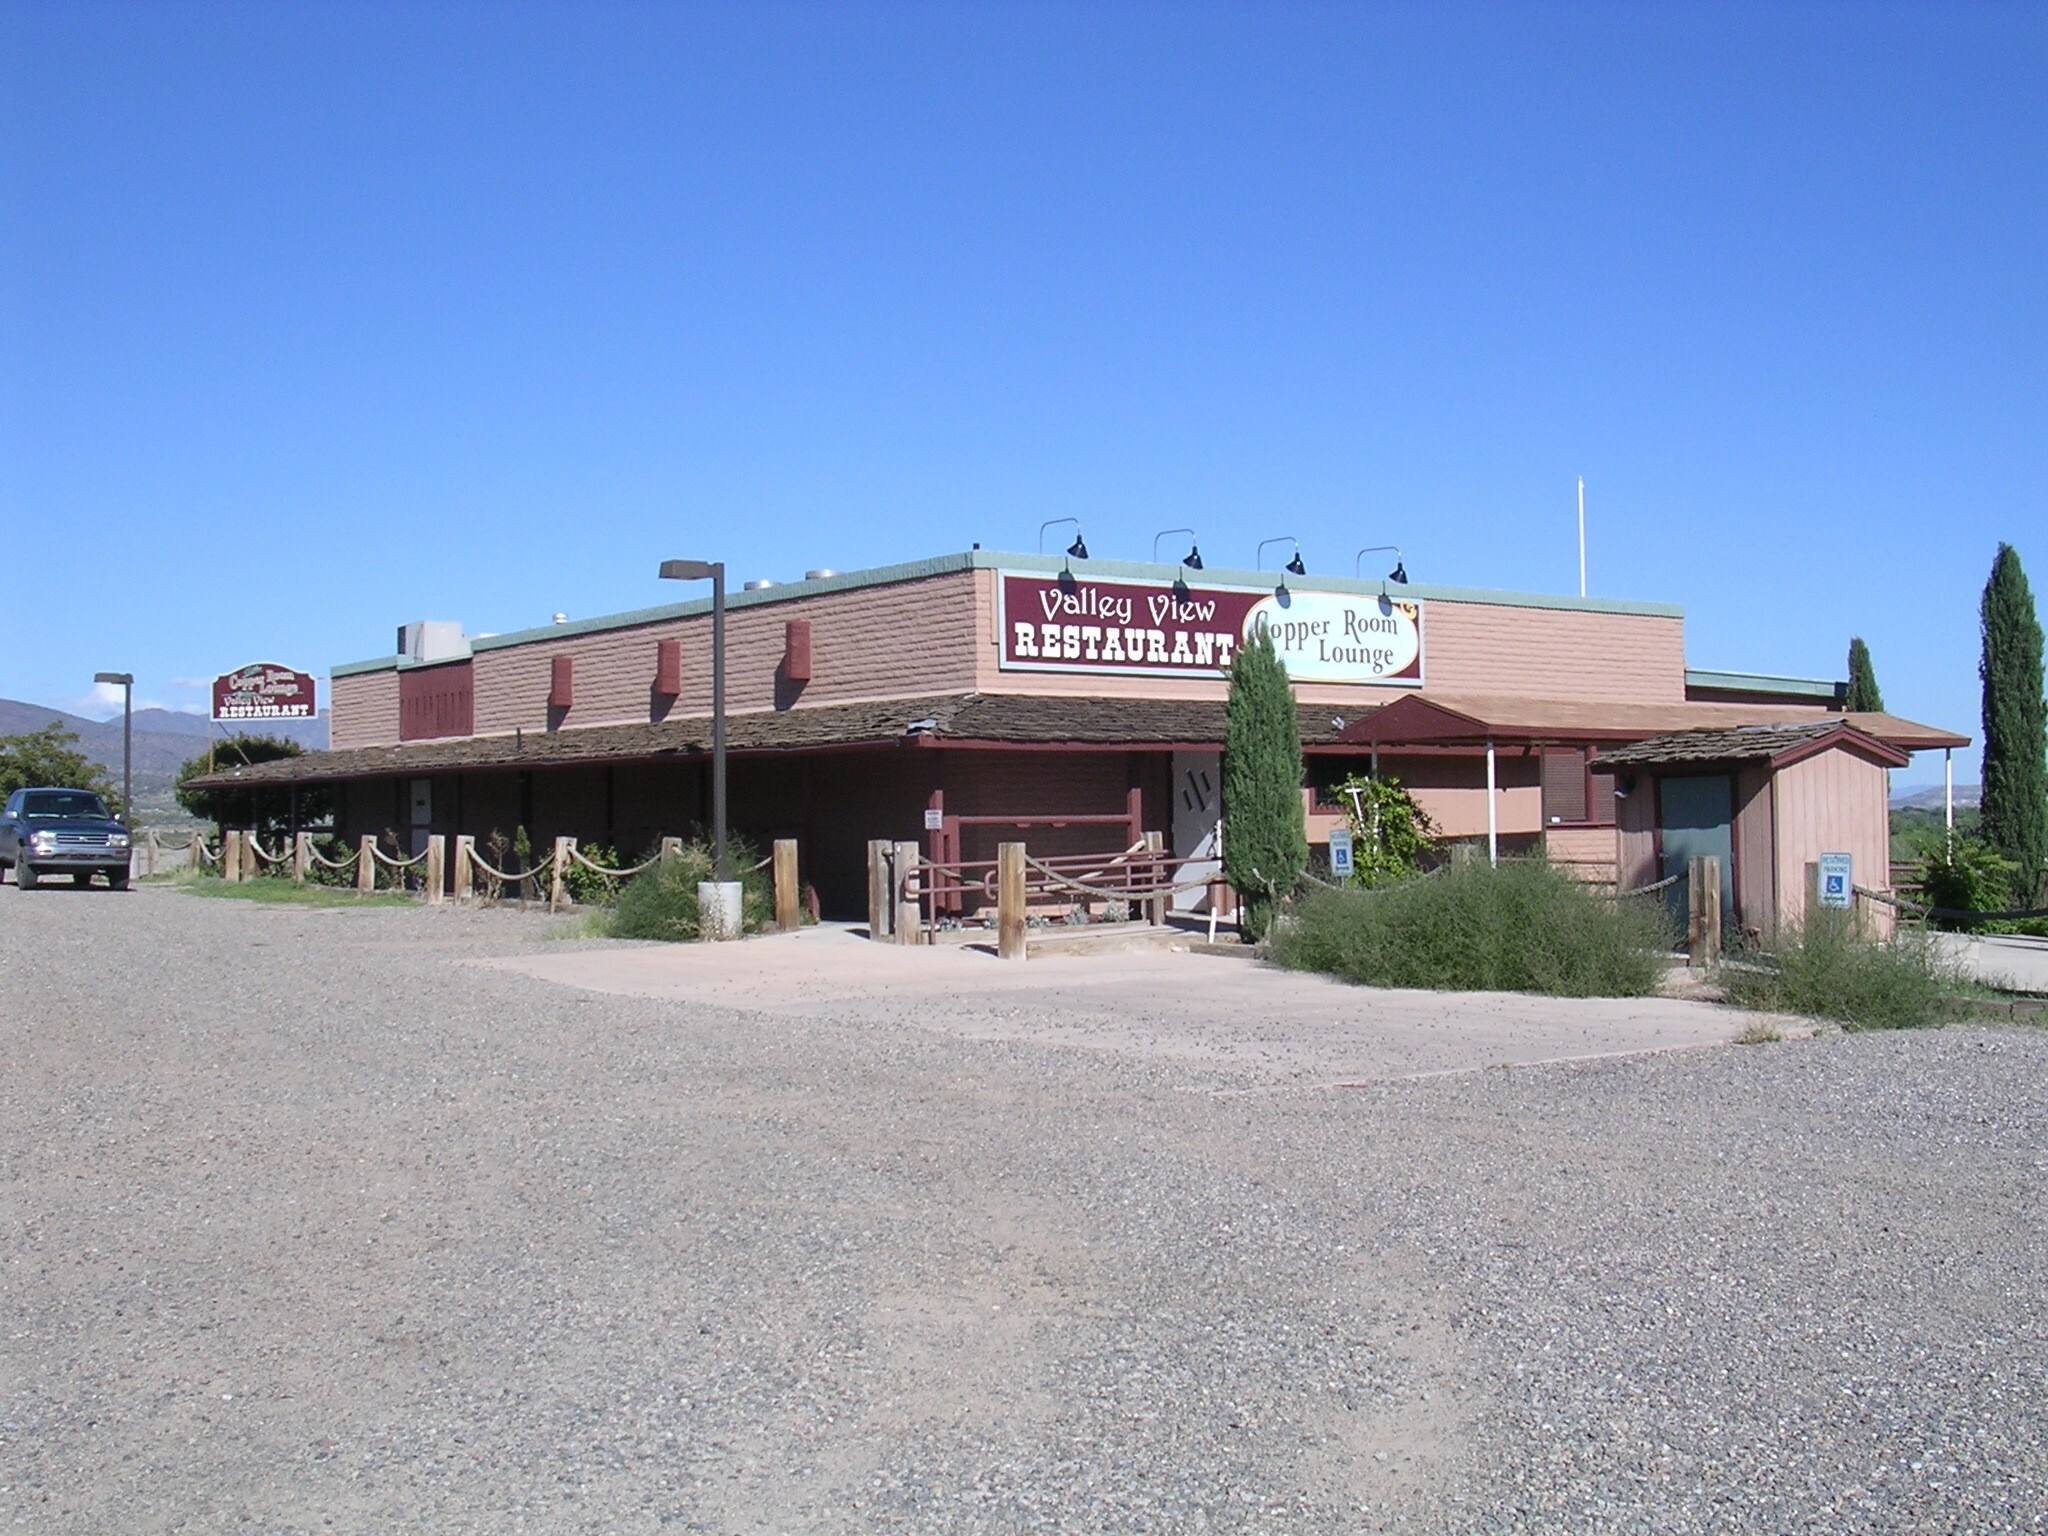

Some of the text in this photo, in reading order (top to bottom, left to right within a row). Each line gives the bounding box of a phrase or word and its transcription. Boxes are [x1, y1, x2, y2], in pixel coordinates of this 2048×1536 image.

[1039, 587, 1216, 627] Valley View
[1014, 622, 1234, 666] RESTAURANT
[1254, 609, 1399, 651] Copper Room
[1319, 639, 1394, 674] Lounge
[220, 705, 309, 717] RESTAURANT
[253, 696, 275, 706] View
